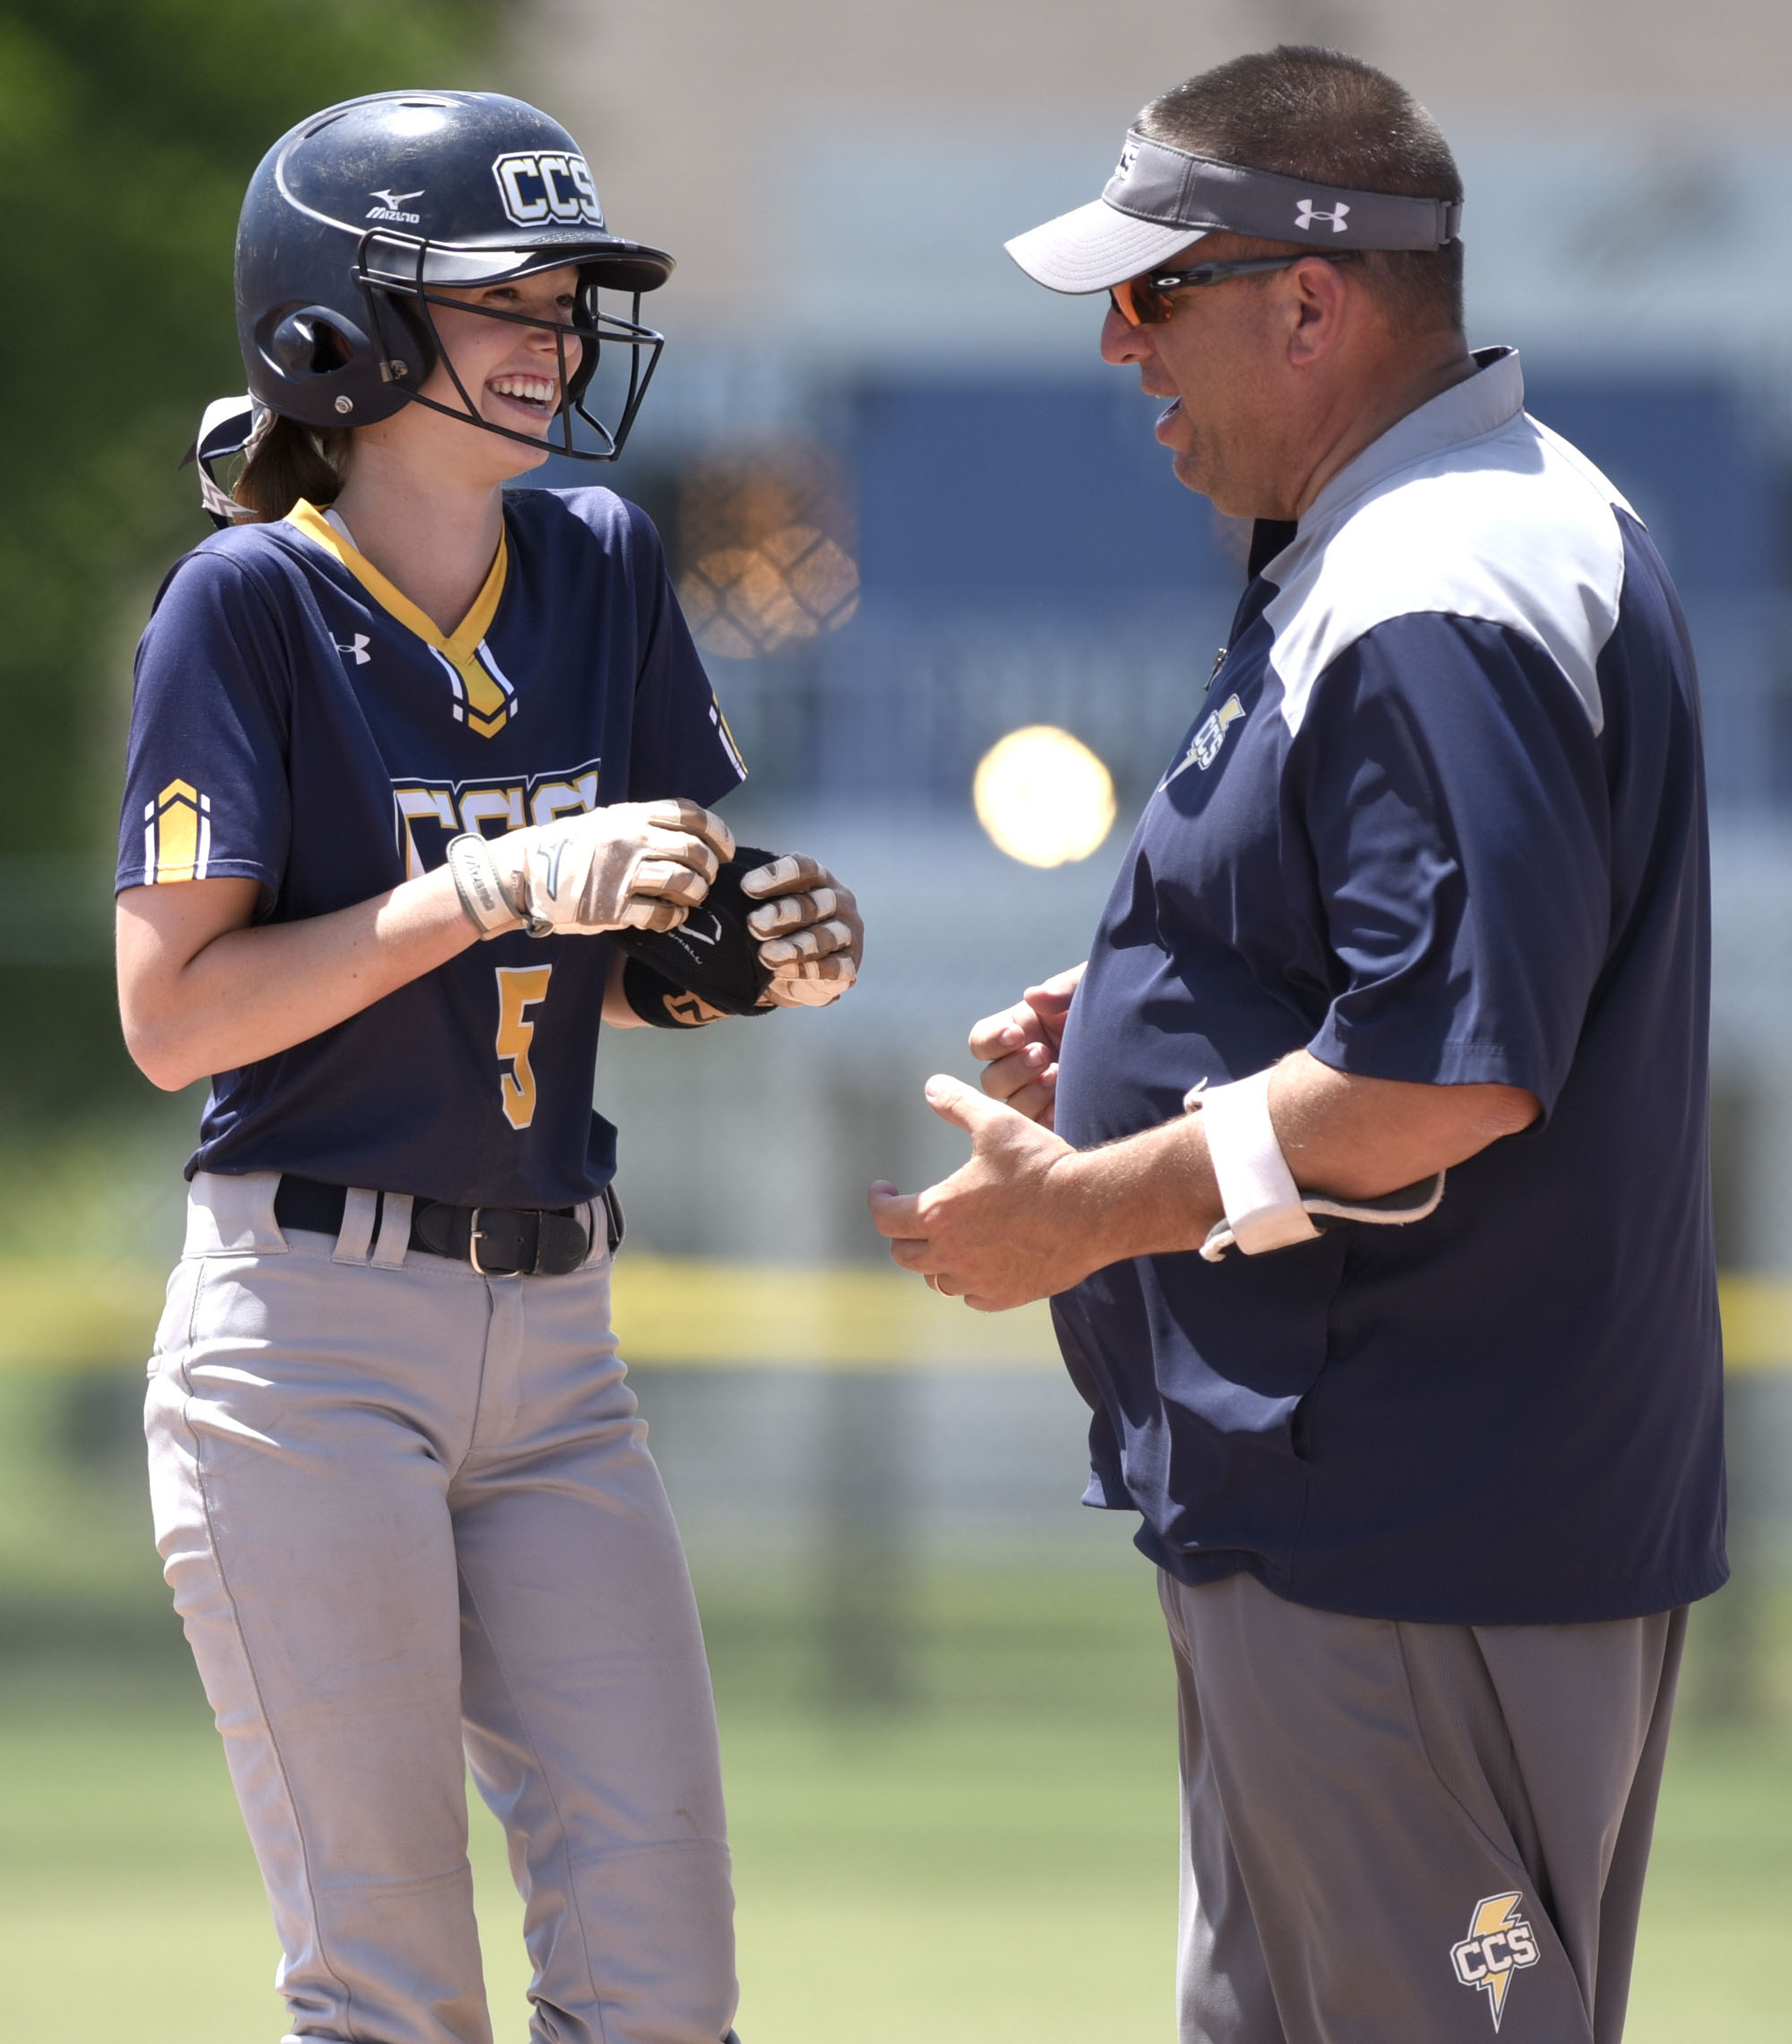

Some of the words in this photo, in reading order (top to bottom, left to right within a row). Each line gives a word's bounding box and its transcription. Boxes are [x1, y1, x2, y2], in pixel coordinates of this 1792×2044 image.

[365, 206, 420, 224] MIZUNO
[497, 154, 601, 222] CCS
[1193, 712, 1225, 768] CCS
[495, 963, 553, 1130] 5
[1455, 1925, 1537, 1983] CCS
